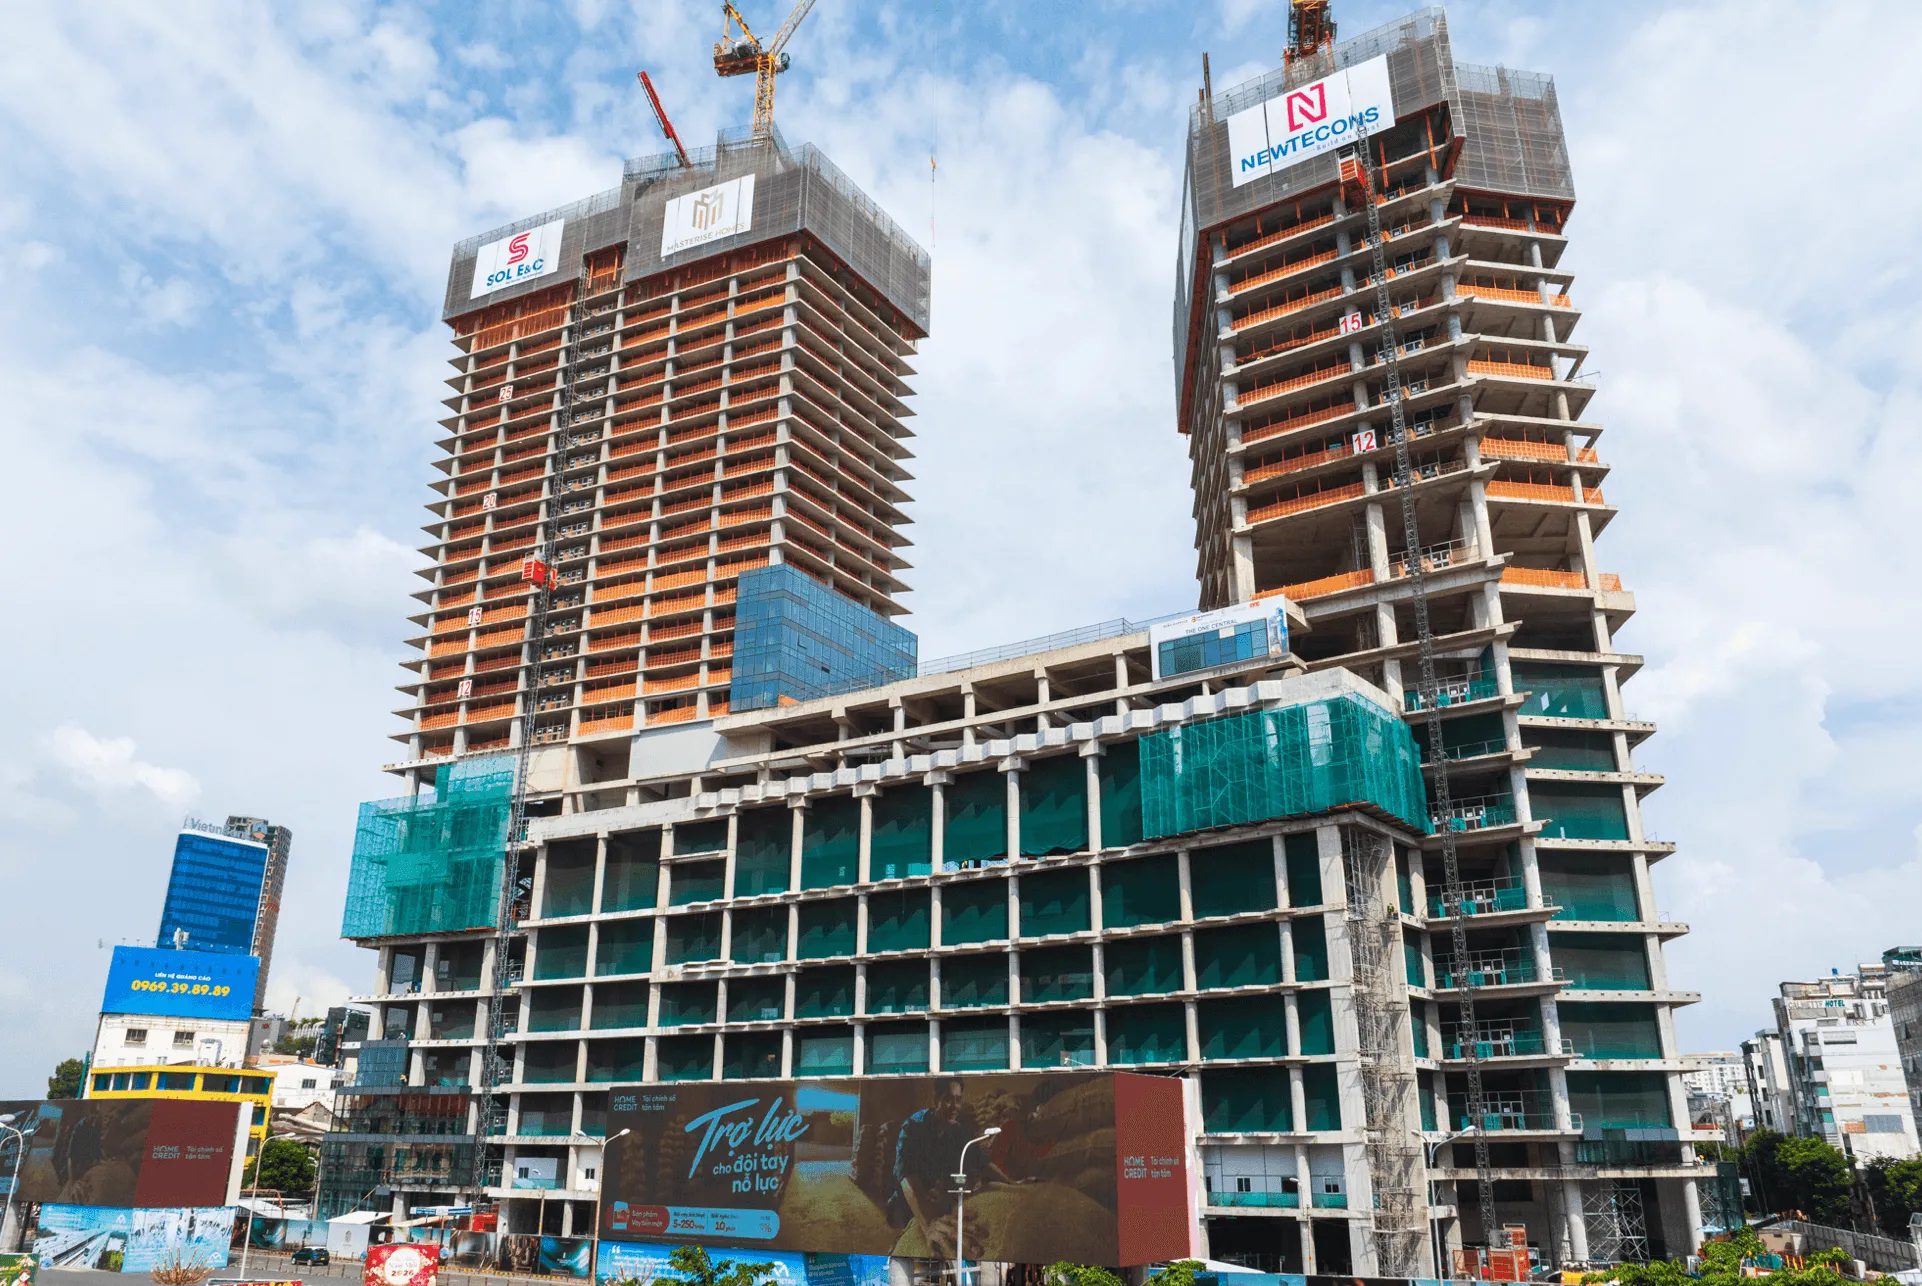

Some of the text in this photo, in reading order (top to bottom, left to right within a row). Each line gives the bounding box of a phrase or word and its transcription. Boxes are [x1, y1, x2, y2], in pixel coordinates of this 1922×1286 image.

[1241, 106, 1380, 173] NEWTECONS
[666, 231, 713, 253] MASTERISE
[486, 268, 512, 287] SOL
[517, 258, 544, 277] E&C
[1341, 313, 1361, 333] 15
[499, 386, 512, 400] 25
[1354, 431, 1375, 452] 12
[483, 494, 496, 508] 20
[469, 609, 481, 623] 15
[1185, 627, 1196, 635] THE
[1211, 619, 1238, 629] CENTRAL
[459, 681, 472, 694] 12
[131, 979, 231, 997] 0969.39.89.89
[1824, 999, 1845, 1007] HOTEL
[614, 1095, 636, 1103] HOME
[613, 1103, 638, 1111] CREDIT
[685, 1096, 810, 1179] Trợ lực
[152, 1152, 181, 1160] CREDIT
[1124, 1156, 1144, 1166] HOME
[712, 1152, 789, 1175] cho đôi tay
[1124, 1168, 1147, 1178] CREDIT
[732, 1172, 780, 1195] nỗ lực
[715, 1221, 726, 1231] 10
